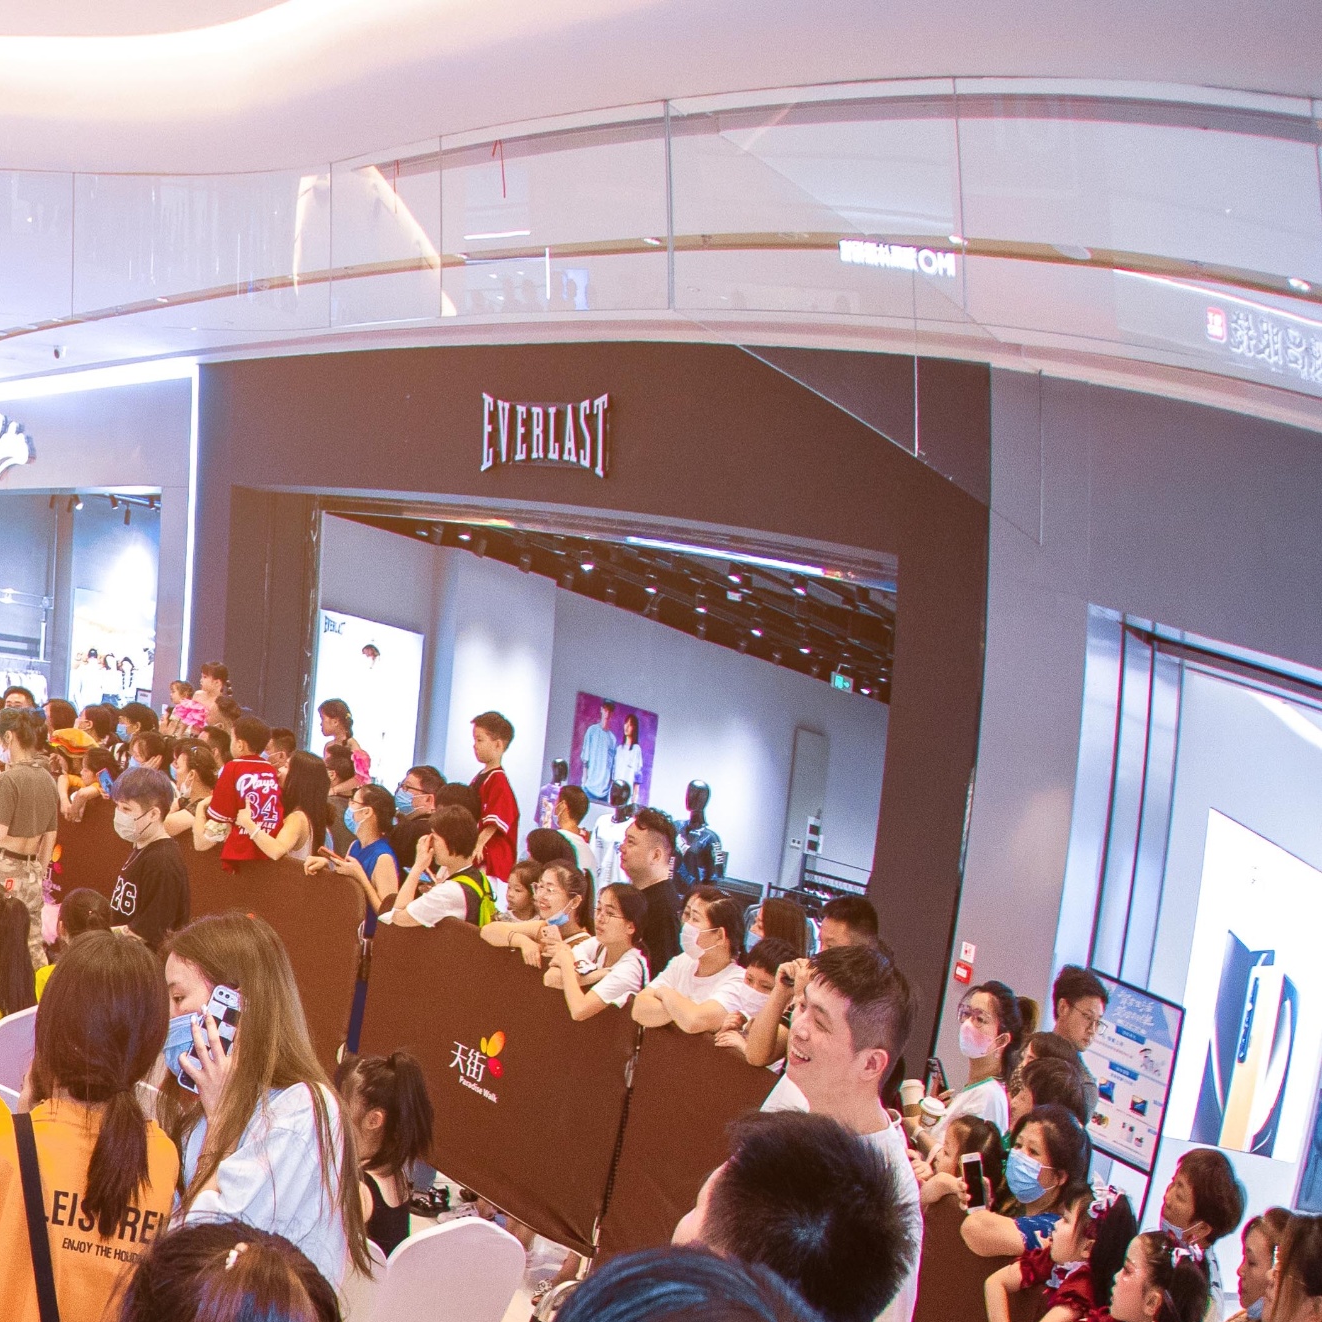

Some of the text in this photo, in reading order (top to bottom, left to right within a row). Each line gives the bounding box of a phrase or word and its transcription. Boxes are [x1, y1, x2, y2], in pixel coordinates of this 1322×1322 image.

[480, 391, 610, 479] EVERLAST
[110, 876, 137, 916] 26
[448, 1040, 487, 1083] 天街
[458, 1075, 498, 1104] Paradise Walk
[62, 1237, 93, 1253] ENJOY
[95, 1244, 112, 1258] THE
